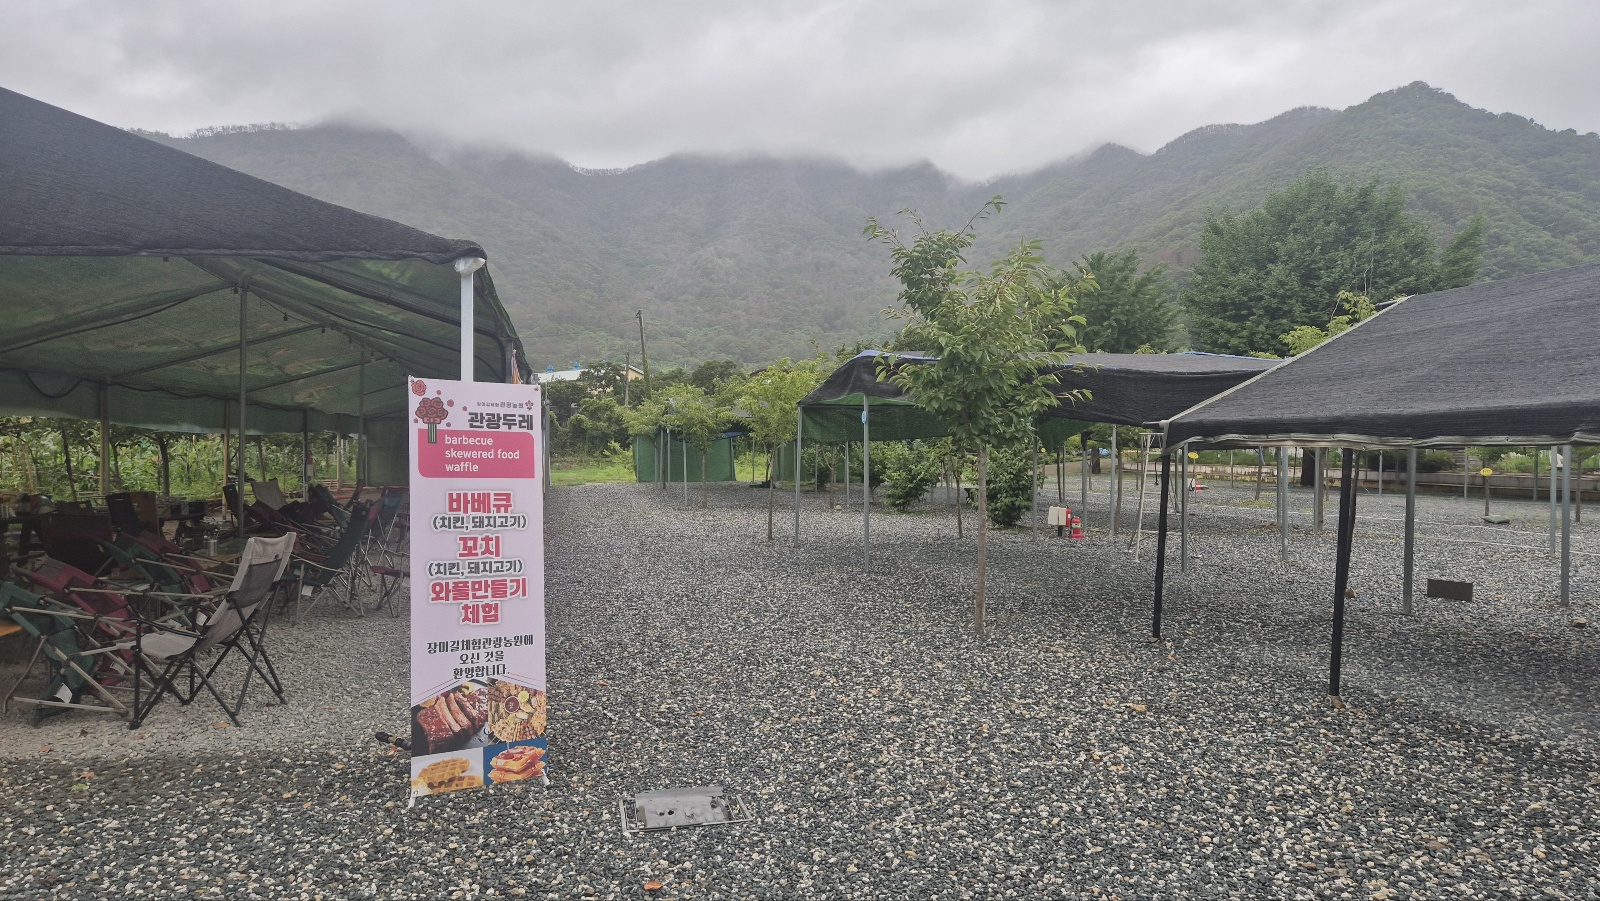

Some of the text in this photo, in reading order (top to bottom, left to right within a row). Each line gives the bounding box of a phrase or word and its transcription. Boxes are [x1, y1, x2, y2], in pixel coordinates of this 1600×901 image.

[468, 412, 534, 430] 관광두레
[444, 434, 494, 446] barbecue
[444, 448, 520, 460] skewered food
[445, 462, 478, 472] waffle
[447, 492, 512, 514] 바베큐
[432, 515, 527, 530] (치킨, 돼지고기)
[458, 535, 500, 557] 꼬치
[428, 560, 523, 576] (치킨, 돼지고기)
[430, 578, 527, 602] 와플만들기
[462, 602, 500, 624] 체험
[426, 634, 534, 654] 장미길체험관광농원에
[460, 650, 504, 664] 오신 것을
[453, 664, 510, 680] 환영합니다.
